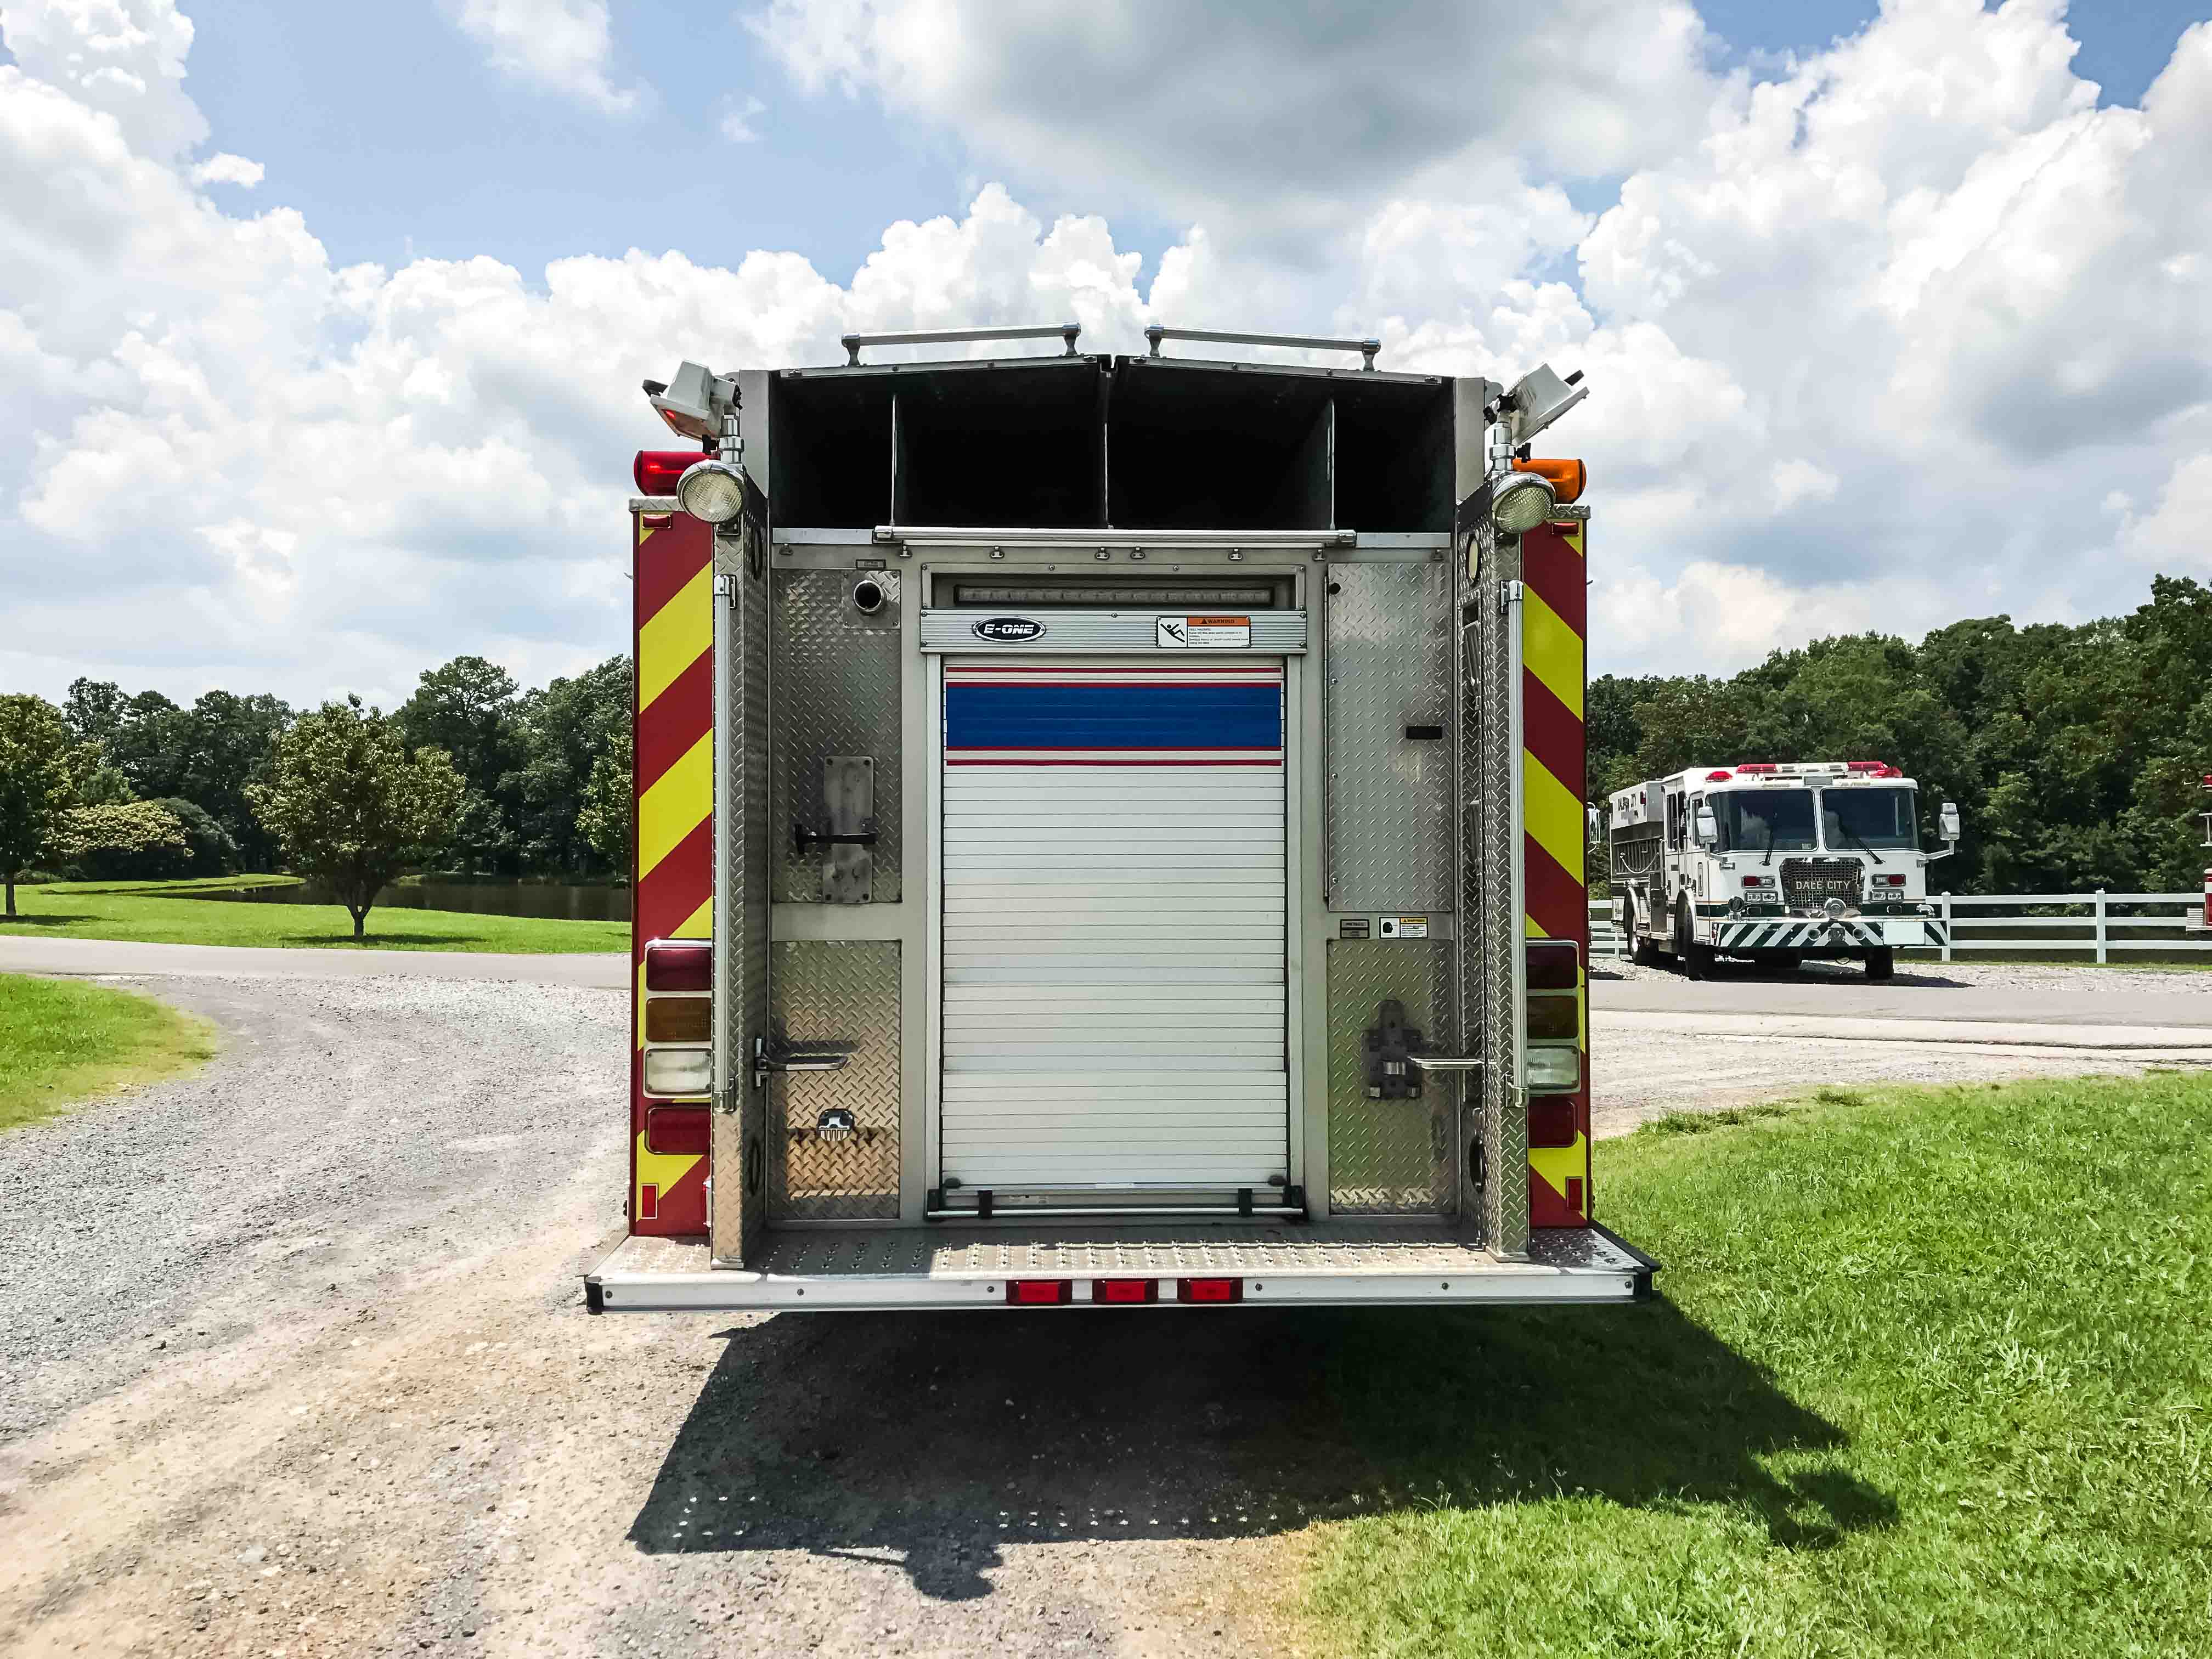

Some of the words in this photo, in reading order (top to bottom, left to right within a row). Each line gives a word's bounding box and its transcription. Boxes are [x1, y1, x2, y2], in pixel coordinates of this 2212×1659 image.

[984, 624, 1035, 634] E-ONE
[1796, 881, 1822, 889] DALE
[1827, 881, 1850, 889] CITY
